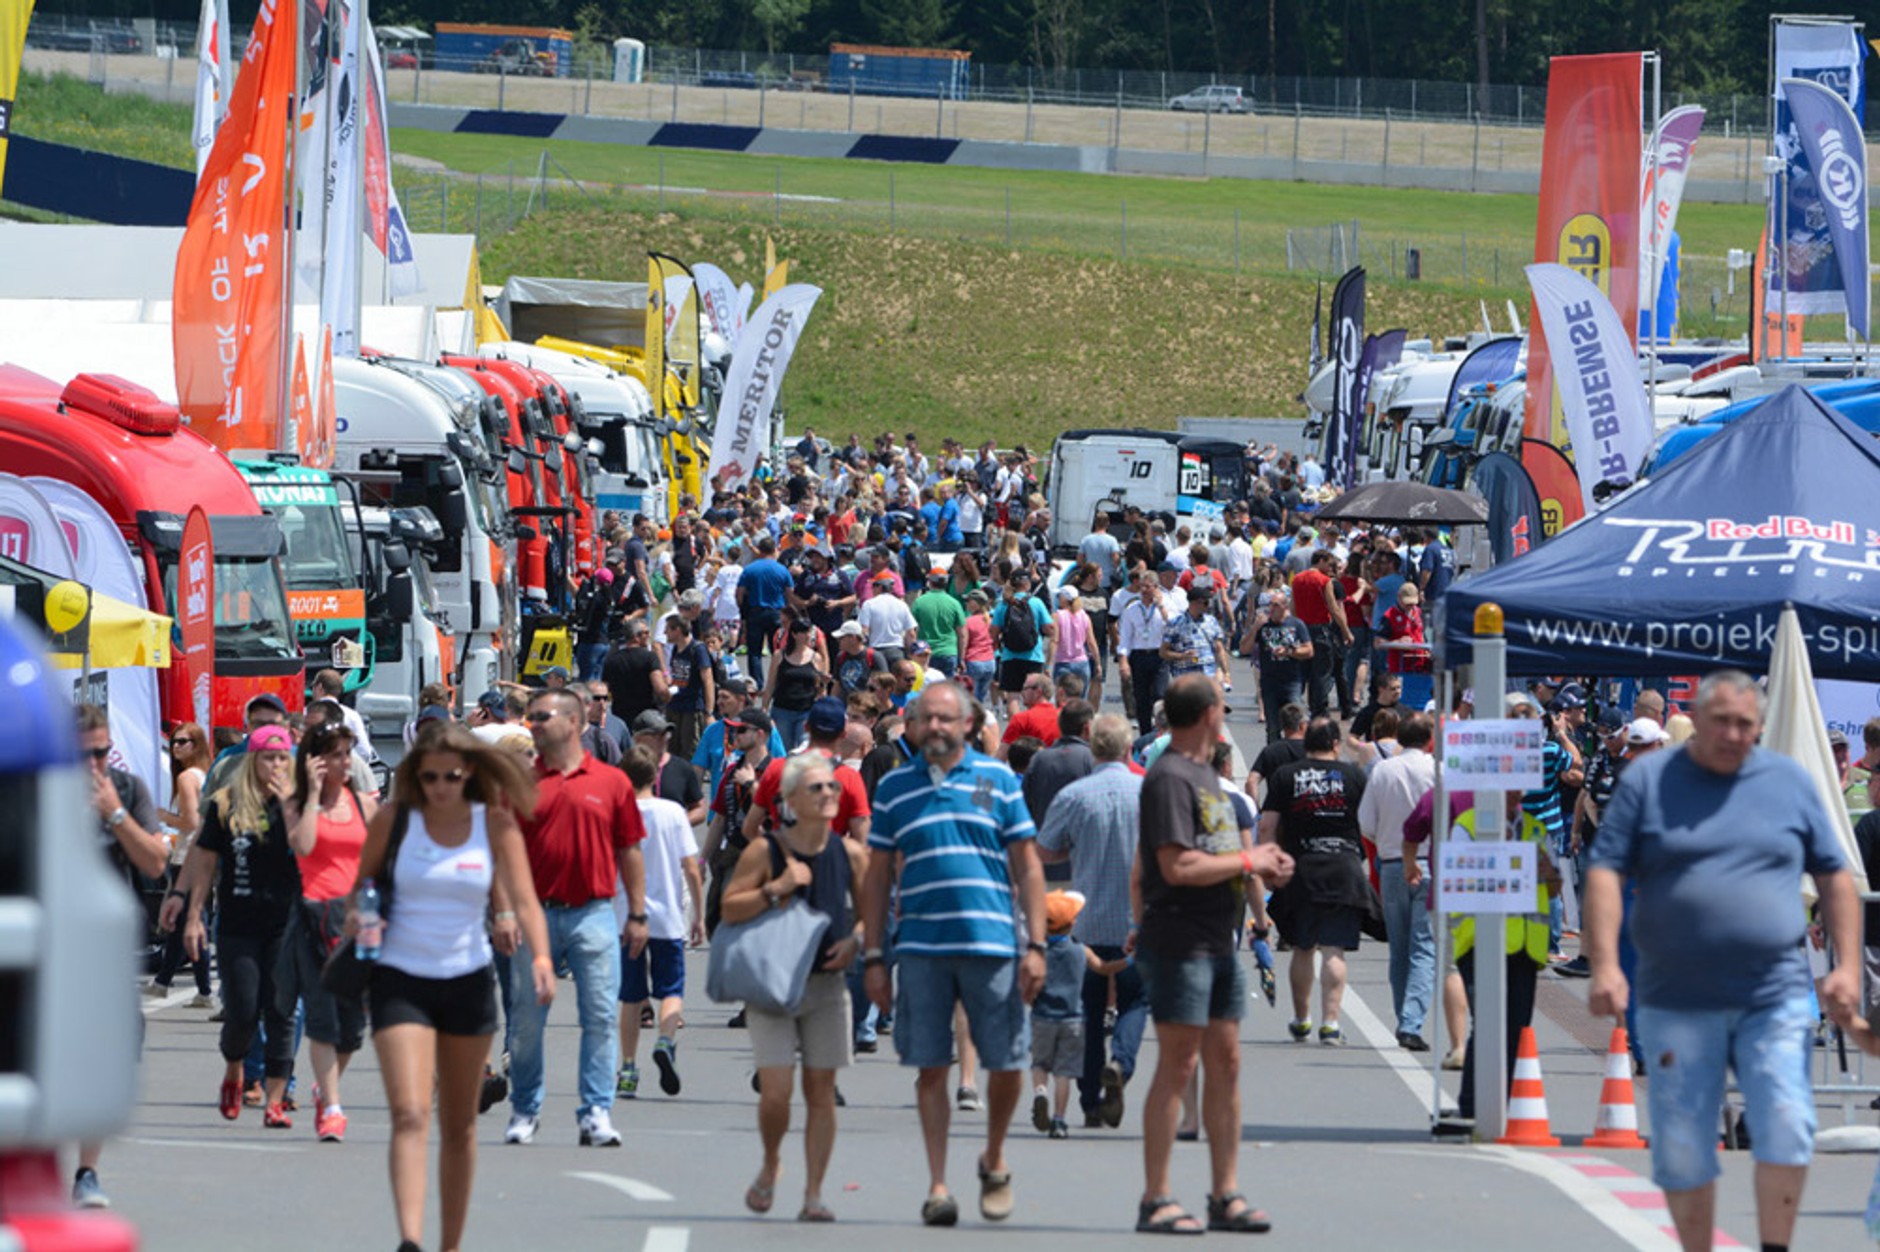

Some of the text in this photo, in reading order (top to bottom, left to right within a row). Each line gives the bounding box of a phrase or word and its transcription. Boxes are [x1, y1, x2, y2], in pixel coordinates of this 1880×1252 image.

[732, 307, 793, 455] MERITOR
[1130, 461, 1152, 478] 10
[1185, 472, 1199, 490] 10
[243, 472, 327, 502] RONAS
[1706, 515, 1783, 543] Red
[1783, 515, 1856, 545] Bull
[1526, 613, 1879, 660] www.projek-spi
